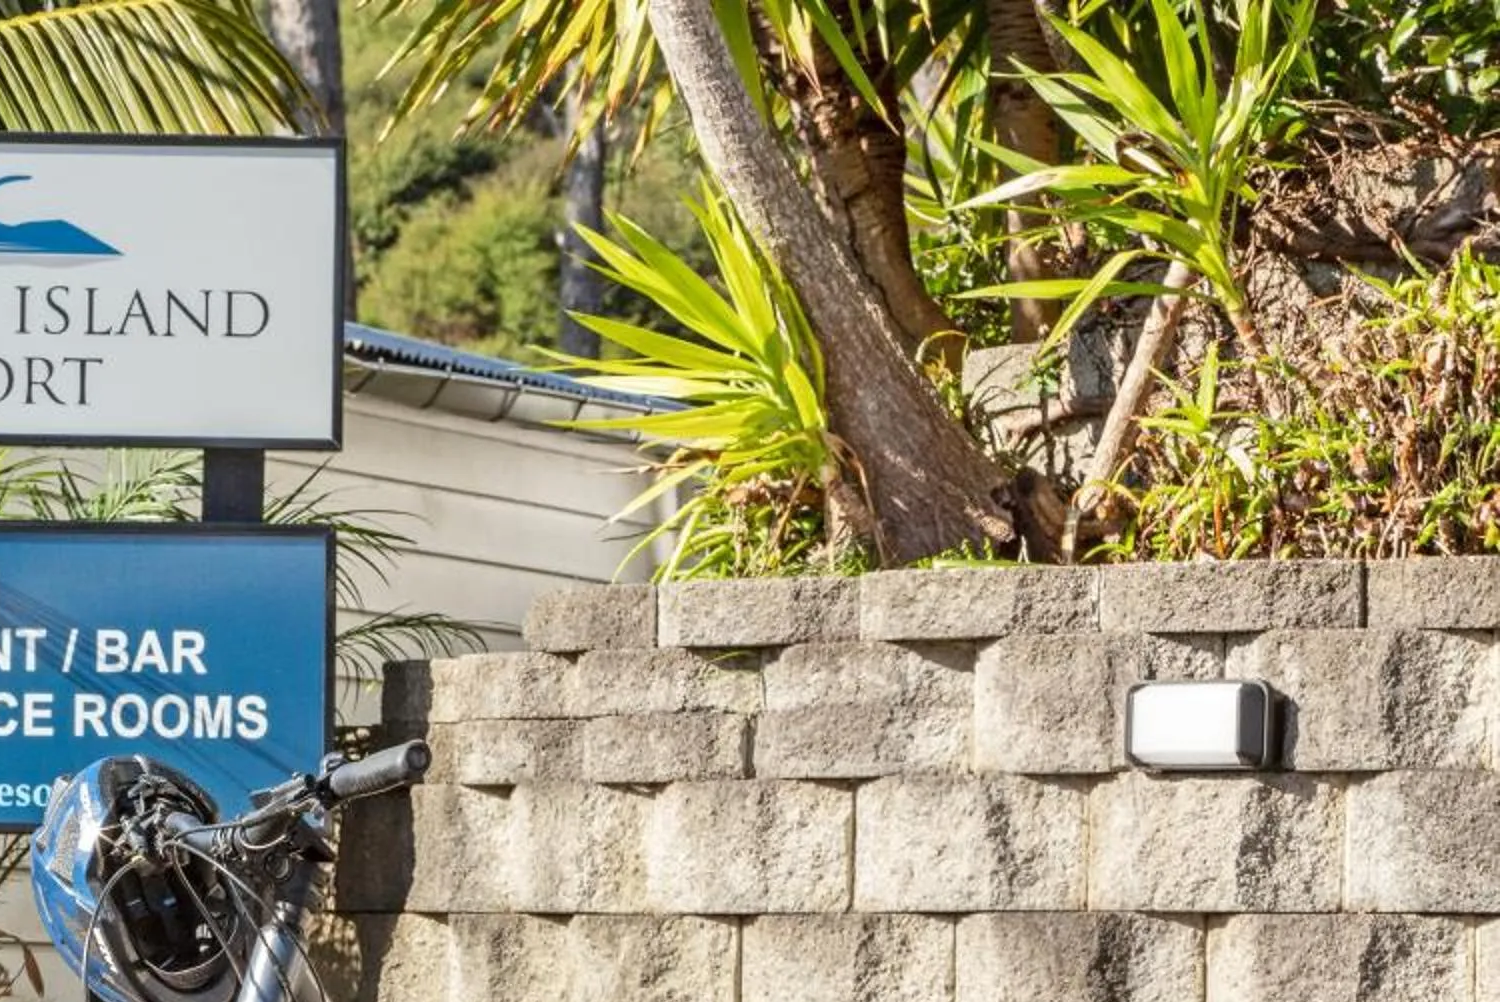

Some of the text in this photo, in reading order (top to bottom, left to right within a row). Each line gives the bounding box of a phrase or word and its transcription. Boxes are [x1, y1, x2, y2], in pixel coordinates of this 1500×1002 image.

[16, 285, 270, 338] ISLAND
[62, 627, 79, 673] /
[95, 629, 207, 675] BAR
[73, 693, 269, 740] ROOMS
